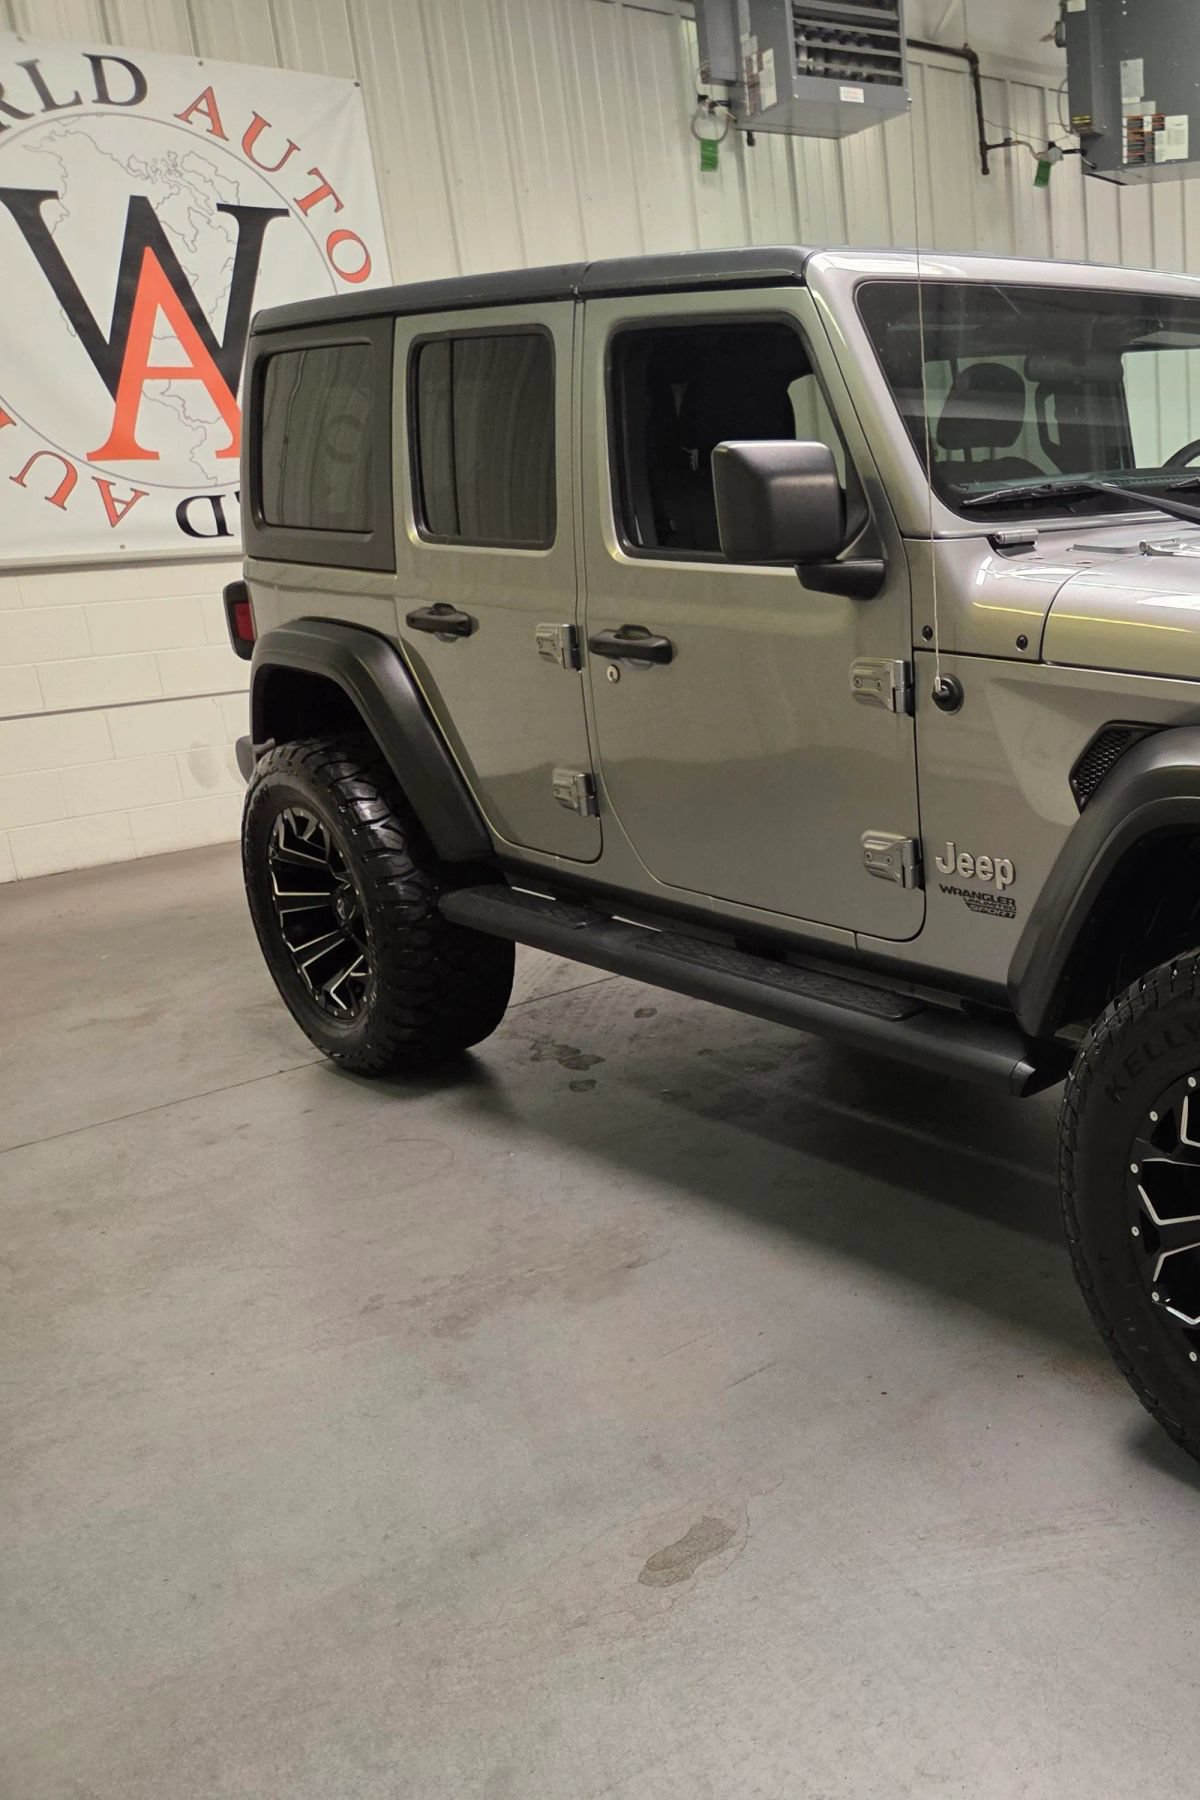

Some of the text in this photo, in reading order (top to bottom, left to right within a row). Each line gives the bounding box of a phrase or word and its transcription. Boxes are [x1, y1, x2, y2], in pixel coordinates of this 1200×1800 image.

[173, 85, 372, 284] AUTO
[175, 490, 241, 539] D
[935, 840, 1017, 891] Jeep
[938, 883, 1017, 907] WRANGLER
